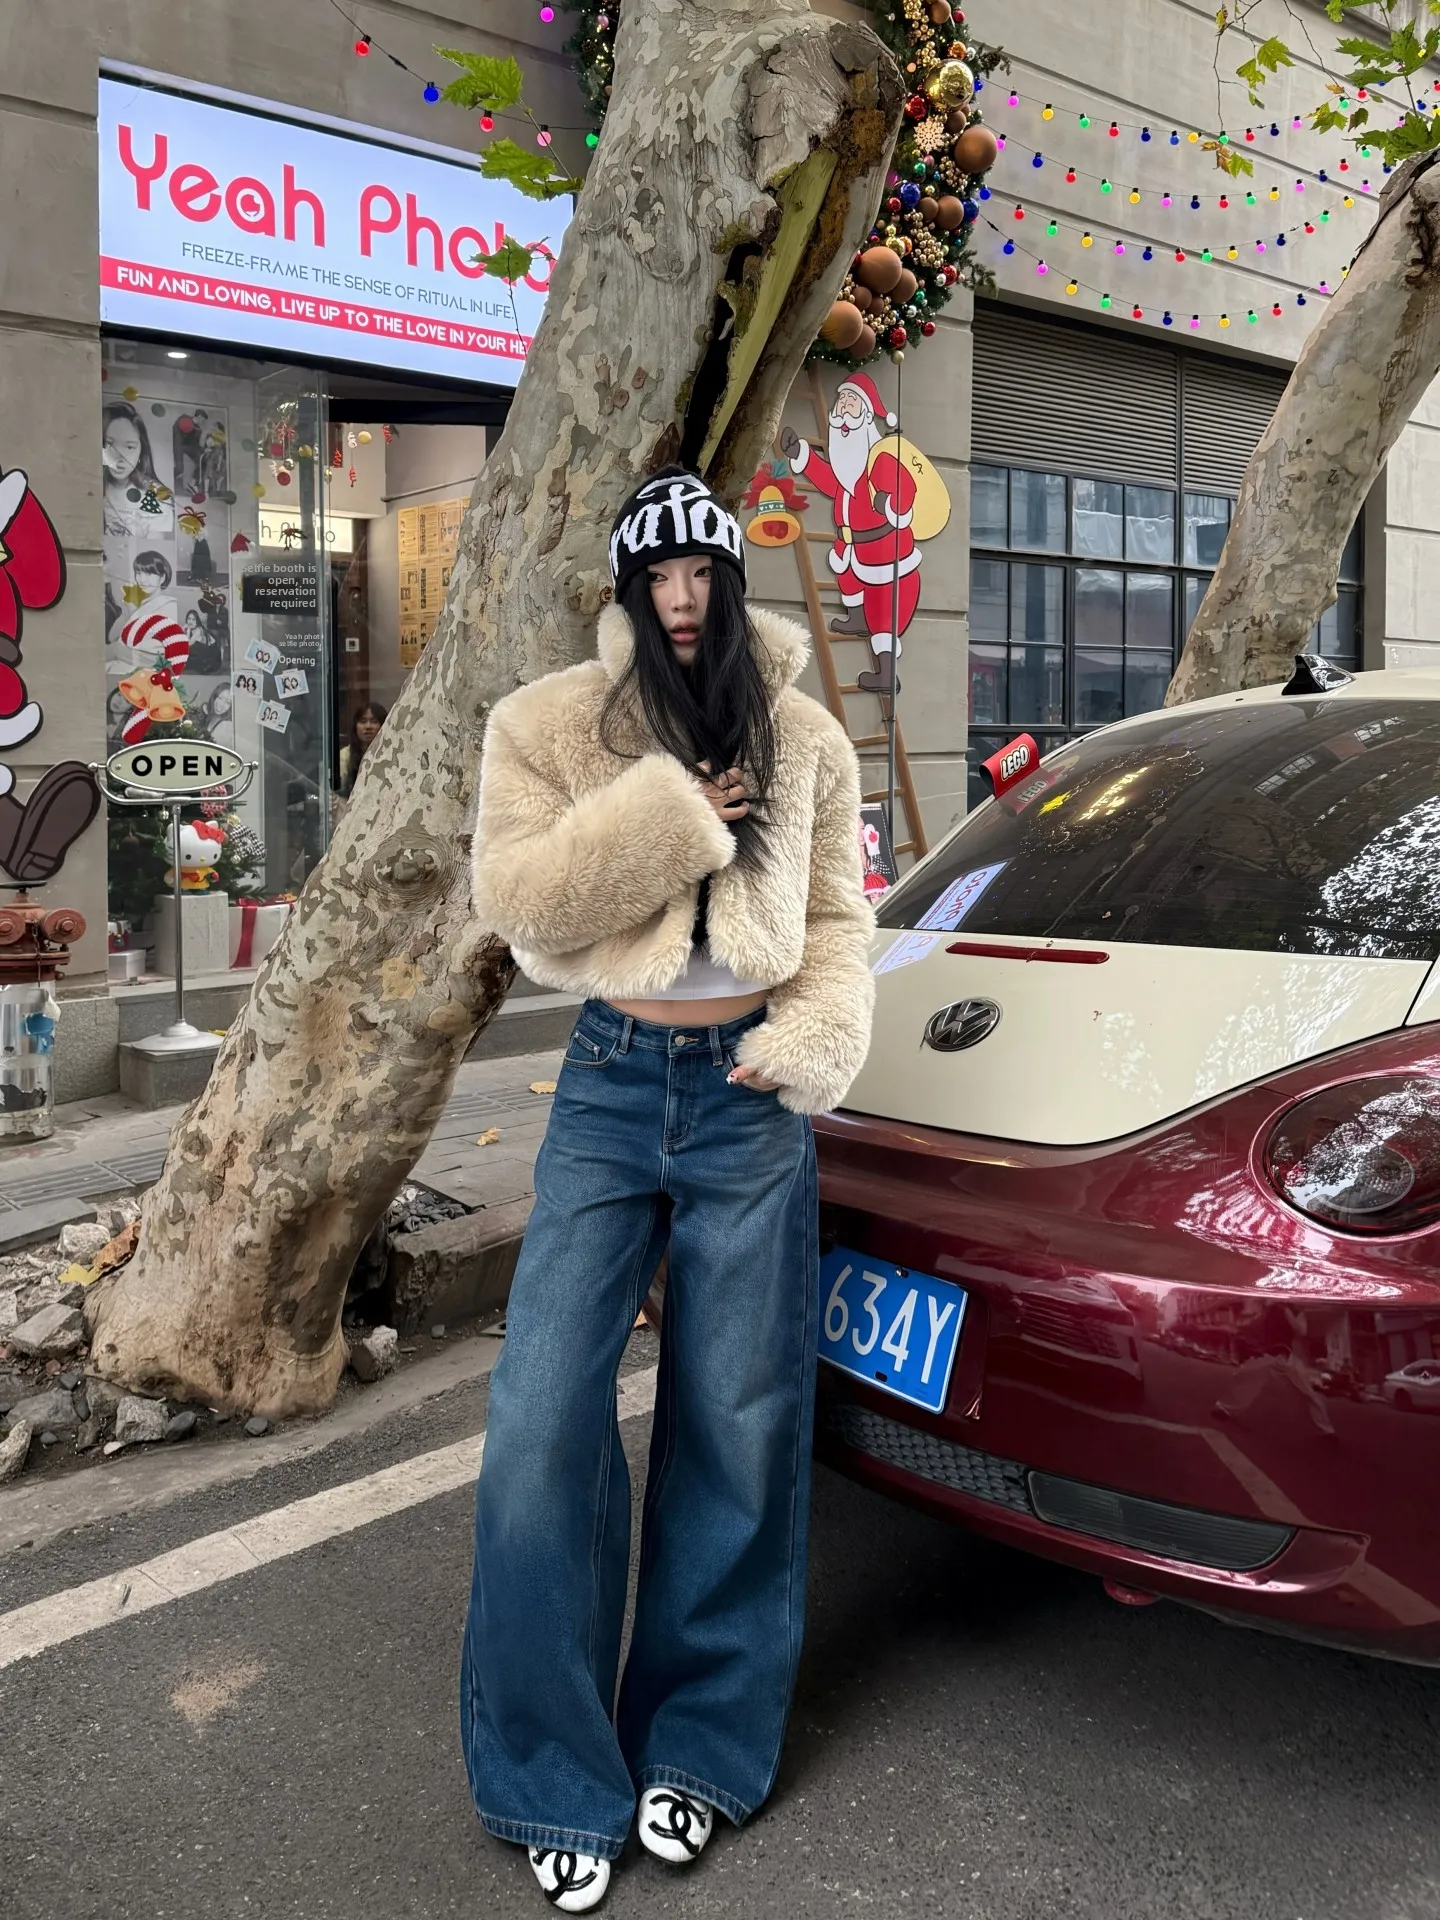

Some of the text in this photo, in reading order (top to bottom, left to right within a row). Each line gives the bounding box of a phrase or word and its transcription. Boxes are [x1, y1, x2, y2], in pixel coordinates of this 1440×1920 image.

[118, 124, 325, 248] Yeah
[182, 241, 514, 320] FREEZE-FRAME THE SENSE OF RITUAL IN LIFE.
[117, 266, 152, 288] FUN
[158, 275, 199, 297] AND
[204, 283, 277, 313] LOVING,
[281, 297, 315, 318] LIVE
[320, 305, 340, 321] UP
[344, 308, 369, 327] TO
[373, 315, 403, 334] THE
[406, 322, 446, 341] LOVE
[450, 330, 464, 344] IN
[467, 332, 506, 351] YOUR
[273, 563, 305, 573] booth
[308, 562, 316, 573] is
[268, 577, 316, 587] open, no
[255, 585, 316, 596] reservation
[270, 598, 316, 610] required
[279, 655, 316, 667] Opening
[131, 755, 223, 776] OPEN
[1001, 744, 1030, 781] LEGO
